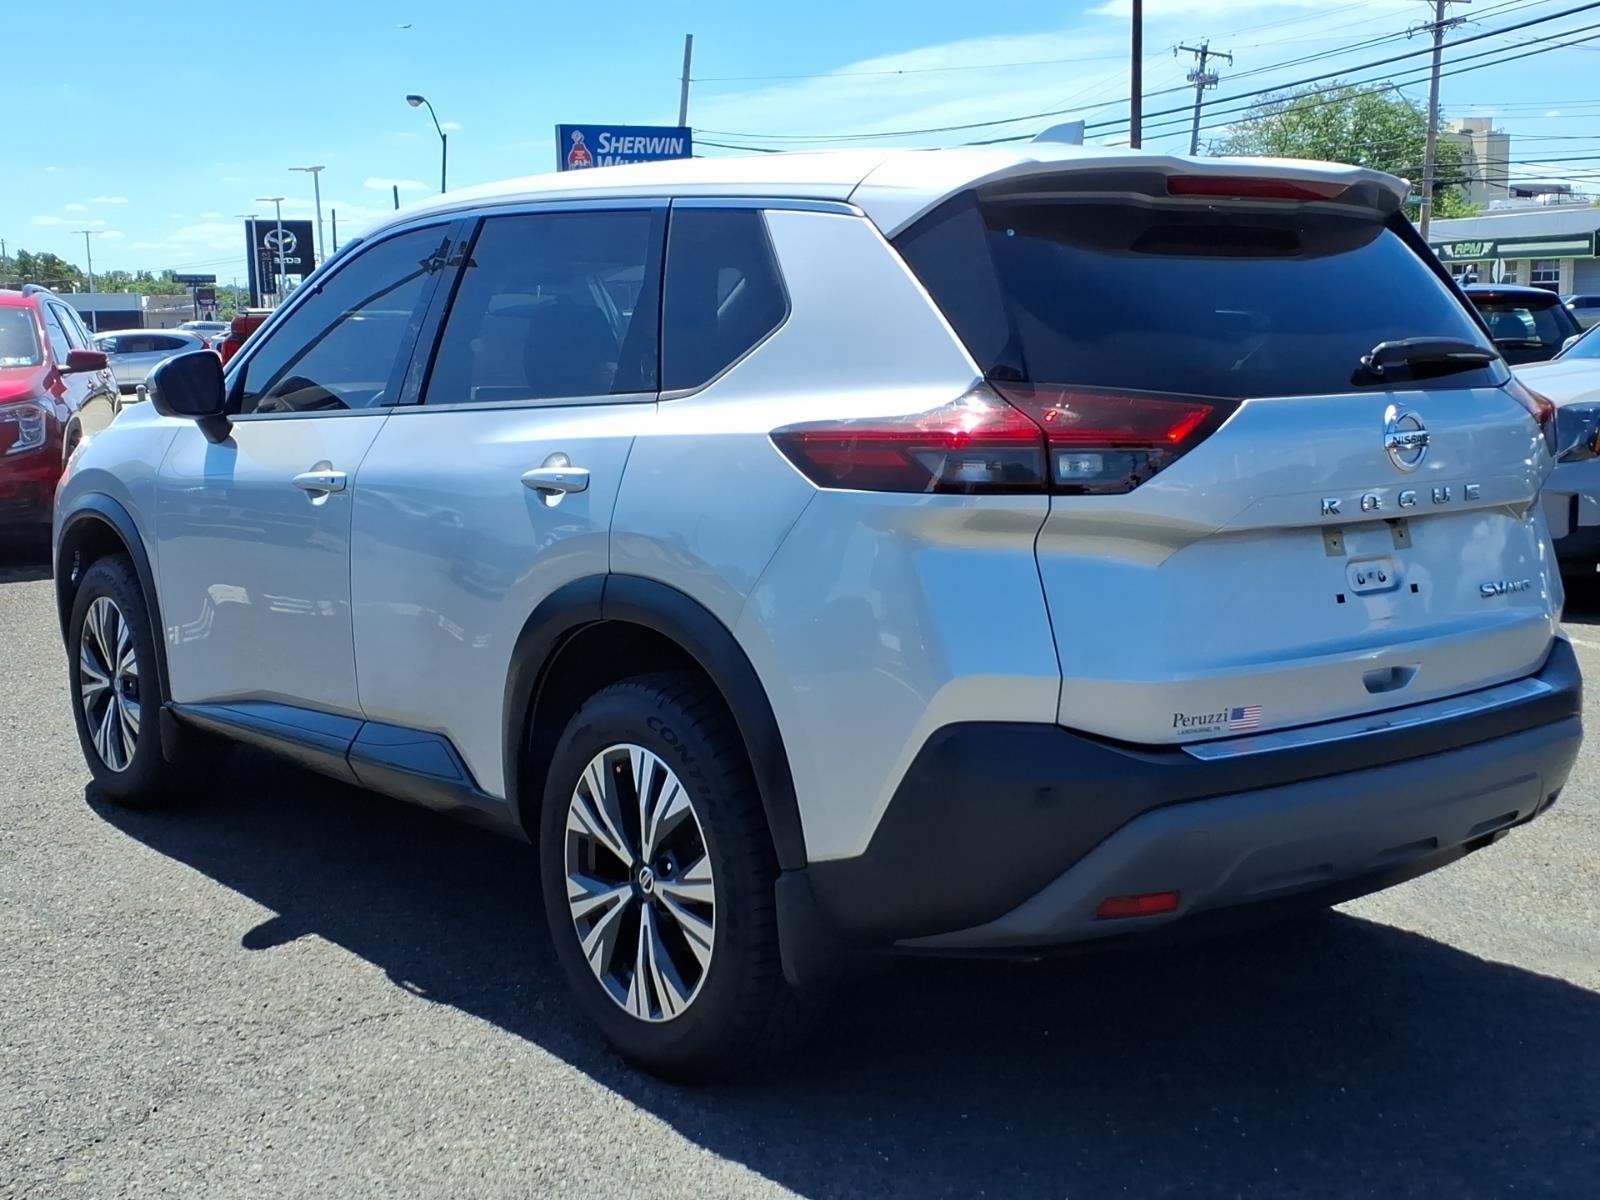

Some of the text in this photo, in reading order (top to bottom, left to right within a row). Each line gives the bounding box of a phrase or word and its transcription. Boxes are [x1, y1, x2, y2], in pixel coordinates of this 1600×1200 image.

[597, 132, 684, 154] SHERWIN
[1454, 242, 1482, 255] RPM
[1321, 484, 1481, 516] ROGUE
[1172, 707, 1228, 728] Peruzzi
